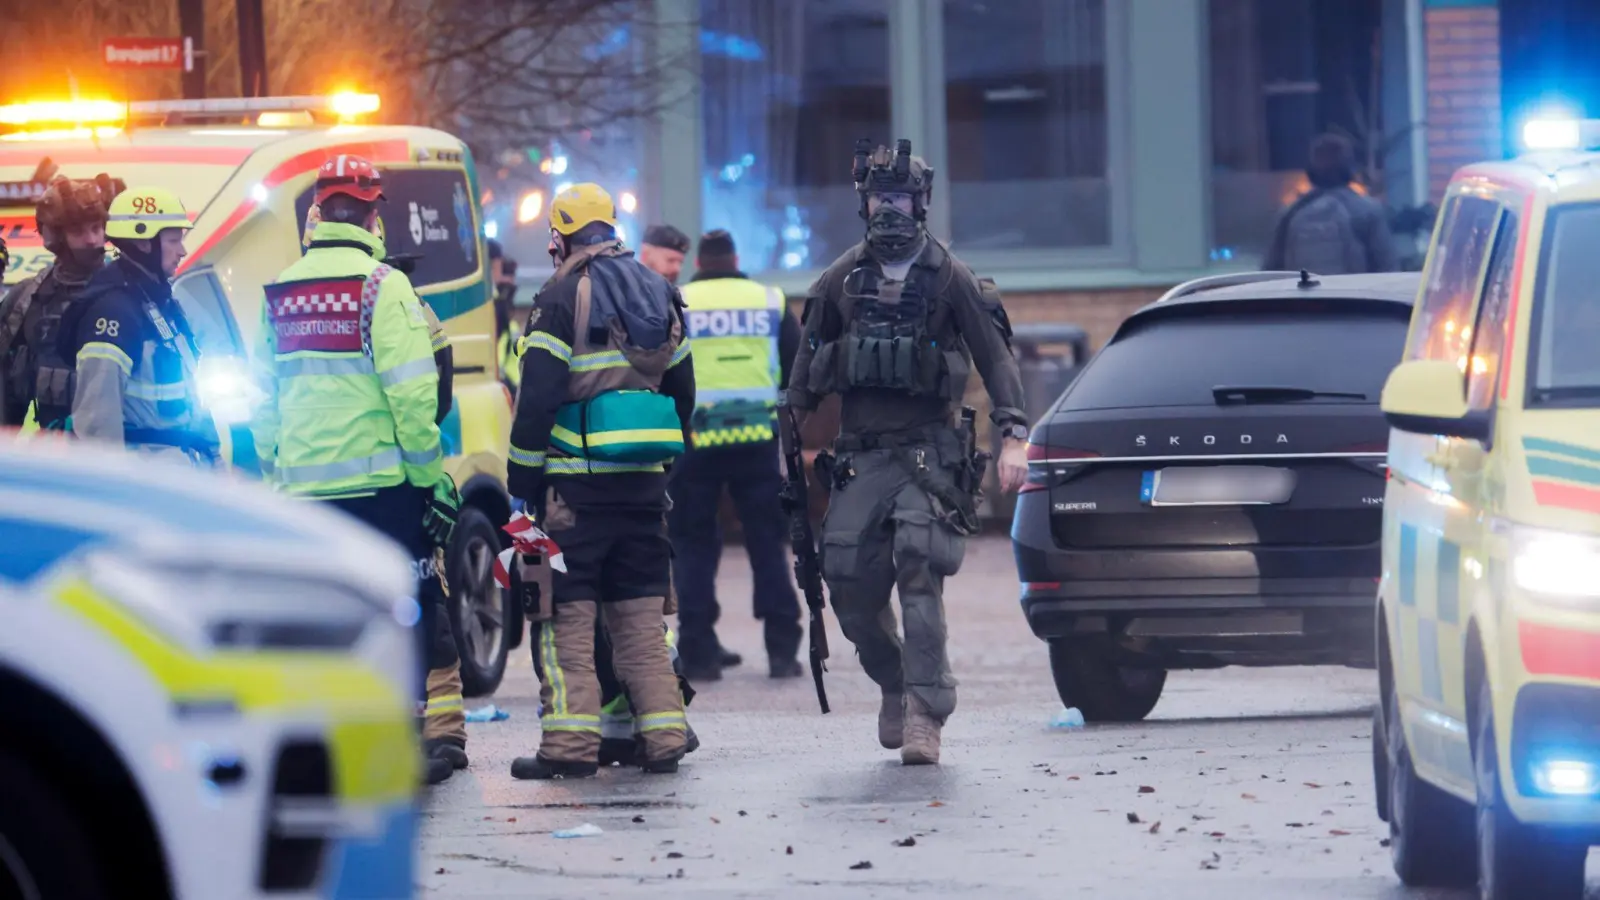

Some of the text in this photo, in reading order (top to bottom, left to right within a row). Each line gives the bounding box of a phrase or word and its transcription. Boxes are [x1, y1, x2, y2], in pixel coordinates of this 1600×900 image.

[132, 197, 157, 214] 98
[95, 318, 120, 336] 98
[690, 310, 770, 337] POLIS
[1135, 434, 1289, 447] ŠKODA
[1054, 502, 1097, 511] SUPERB
